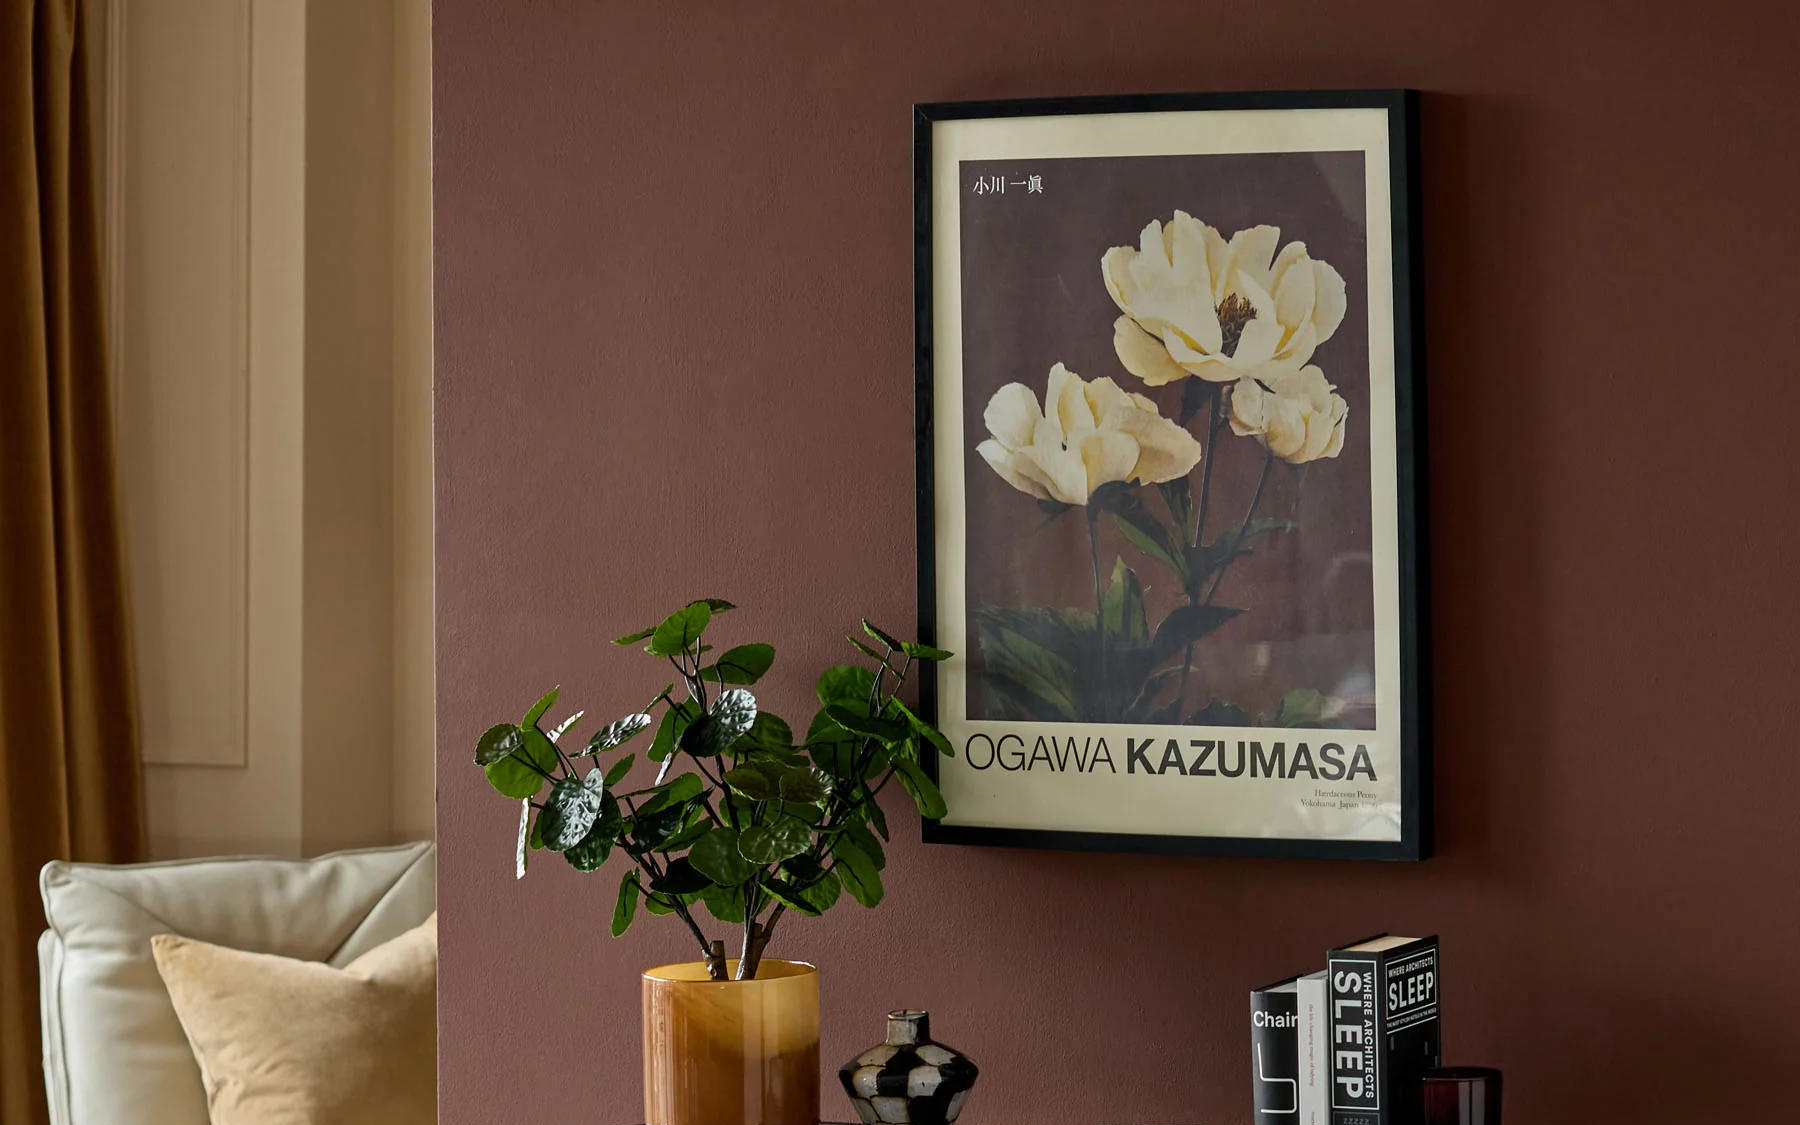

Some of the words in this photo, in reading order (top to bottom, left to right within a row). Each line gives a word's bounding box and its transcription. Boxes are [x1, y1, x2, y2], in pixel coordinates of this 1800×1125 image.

[965, 733, 1116, 773] OGAWA
[1126, 738, 1377, 782] KAZUMASA
[1338, 800, 1359, 810] Japan
[1388, 965, 1405, 978] WHERE
[1405, 956, 1433, 973] ARCHITECTS
[1363, 972, 1373, 1016] WHERE
[1388, 971, 1434, 1011] SLEEP
[1253, 1010, 1298, 1027] Chair
[1334, 970, 1363, 1098] SLEEP
[1363, 1020, 1374, 1099] ARCHITECTS
